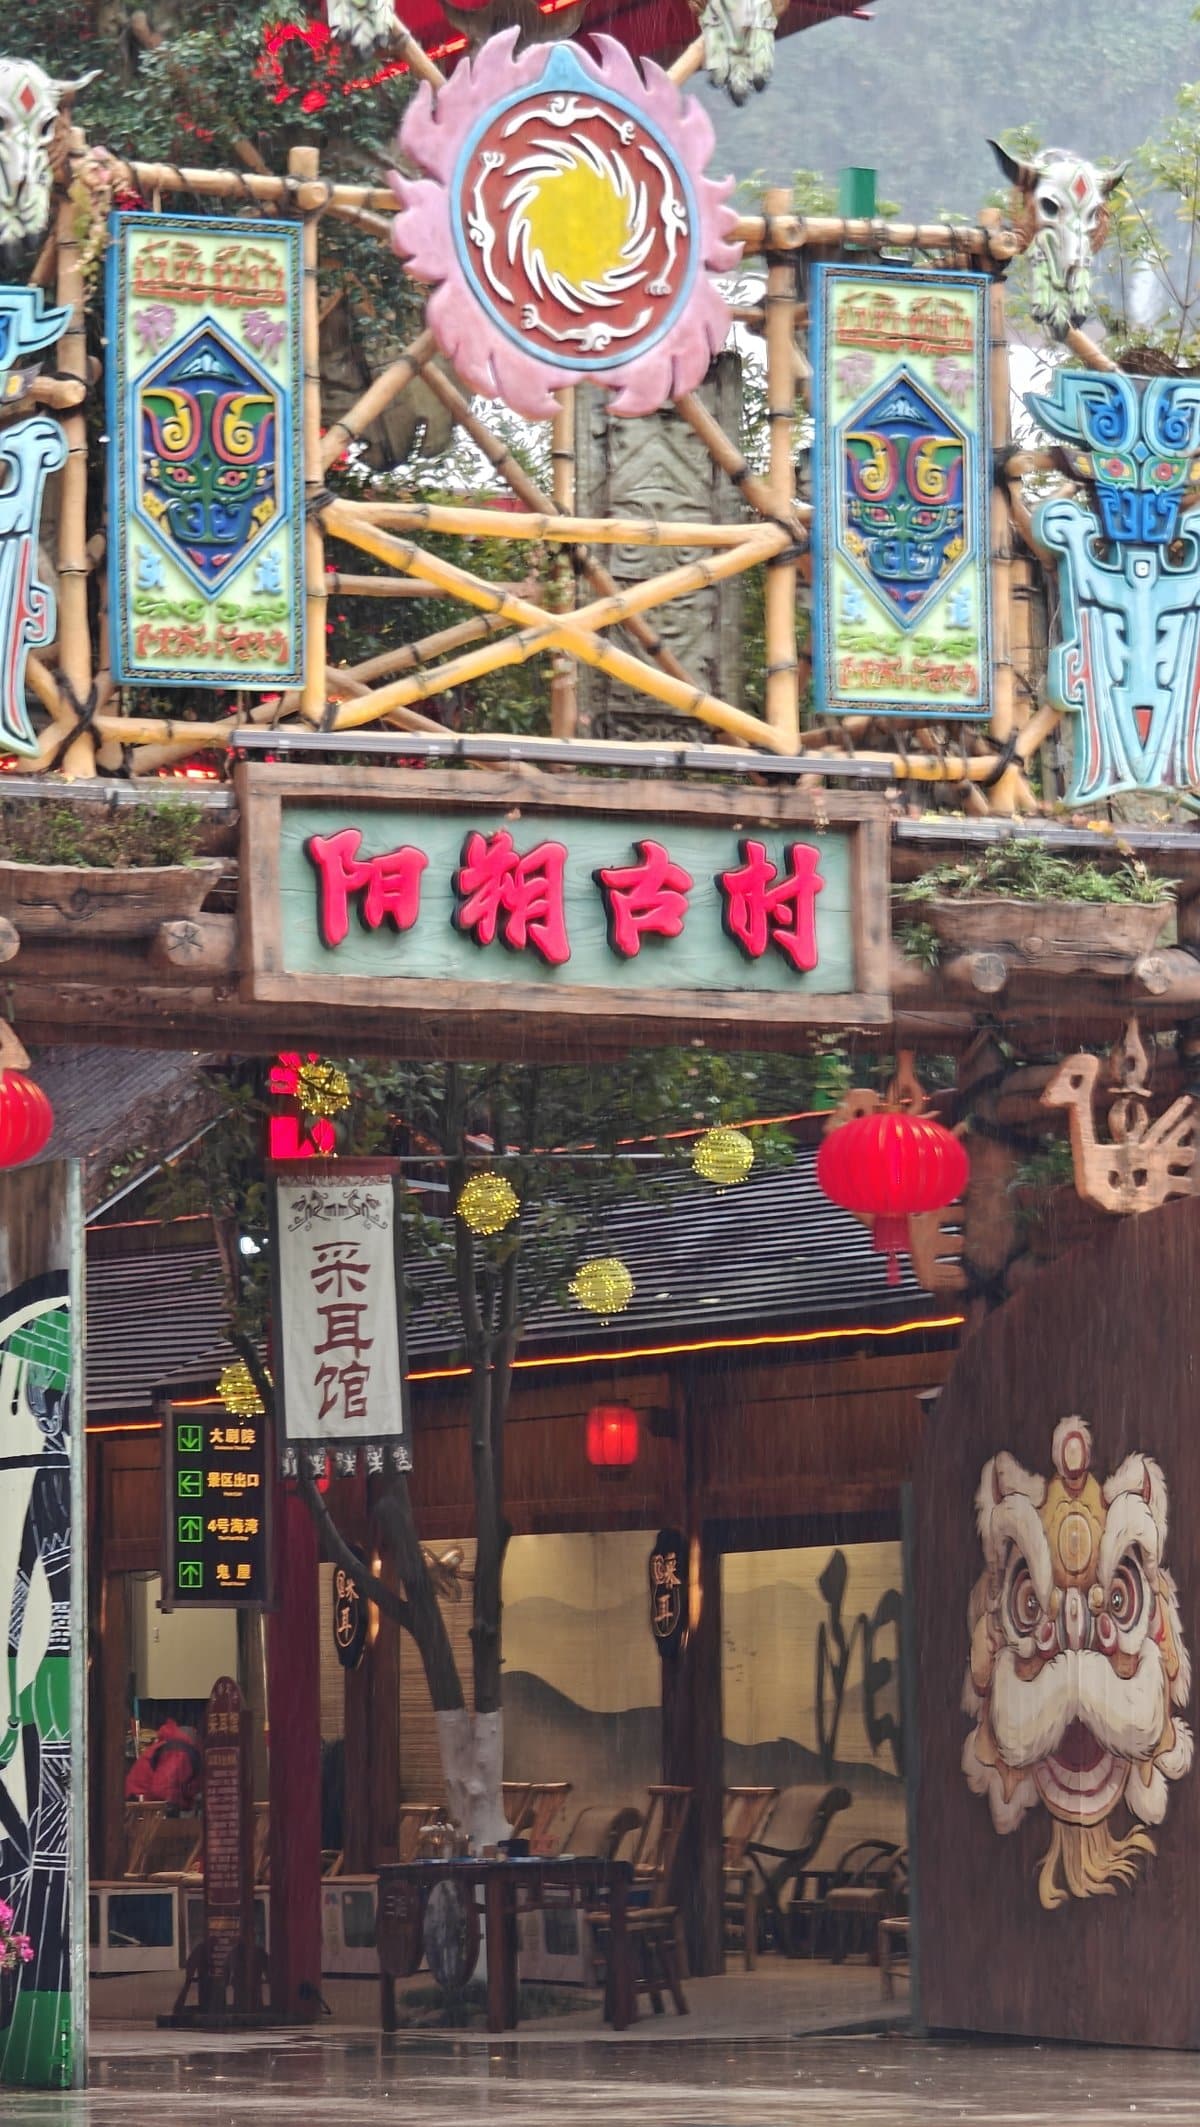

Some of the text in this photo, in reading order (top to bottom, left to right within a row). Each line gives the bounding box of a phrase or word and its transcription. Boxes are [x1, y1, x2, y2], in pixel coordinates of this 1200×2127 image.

[304, 827, 825, 972] 阳朔古村
[311, 1241, 375, 1420] 采耳馆
[209, 1427, 257, 1444] 大剧院
[207, 1471, 260, 1488] 景区出口
[207, 1518, 259, 1534] 4号海湾
